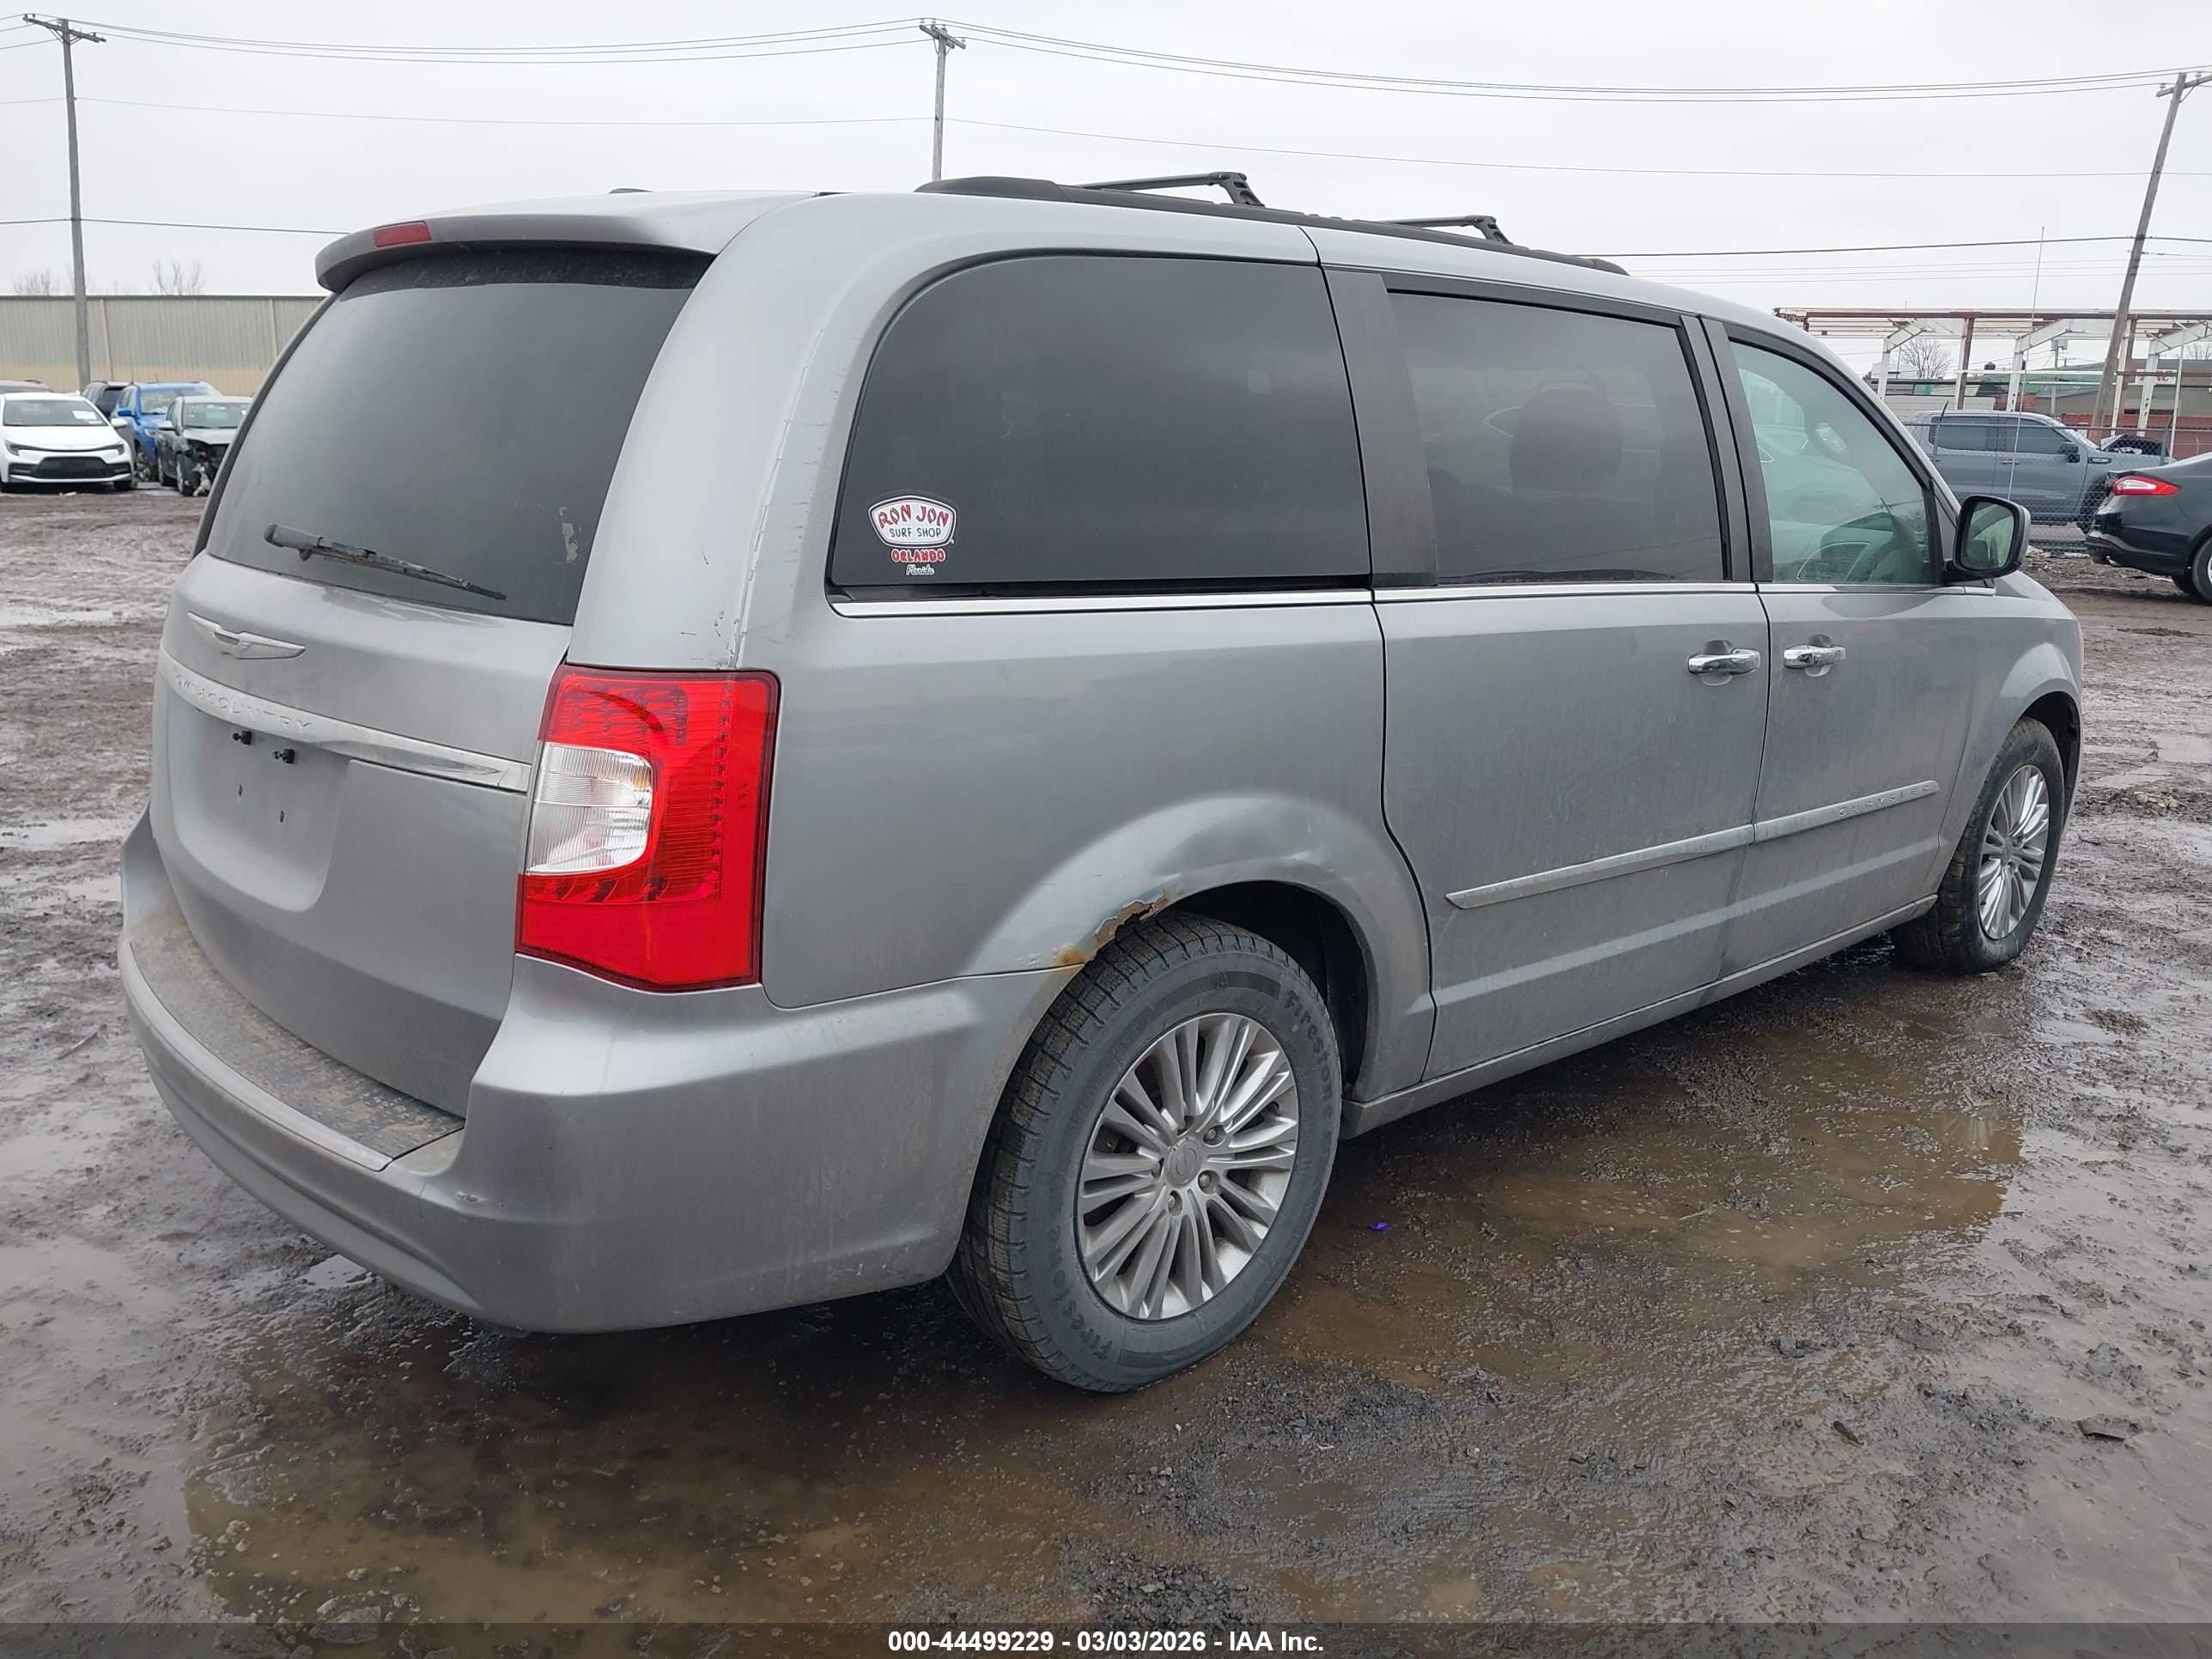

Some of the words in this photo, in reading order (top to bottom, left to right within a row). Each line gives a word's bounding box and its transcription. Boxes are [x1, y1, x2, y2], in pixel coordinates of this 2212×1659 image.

[878, 504, 911, 529] RON
[915, 506, 950, 527] JON
[890, 527, 912, 538] SURF
[916, 527, 941, 538] SHOP
[891, 549, 945, 562] ORLANDO
[1284, 989, 1333, 1119] Firestone
